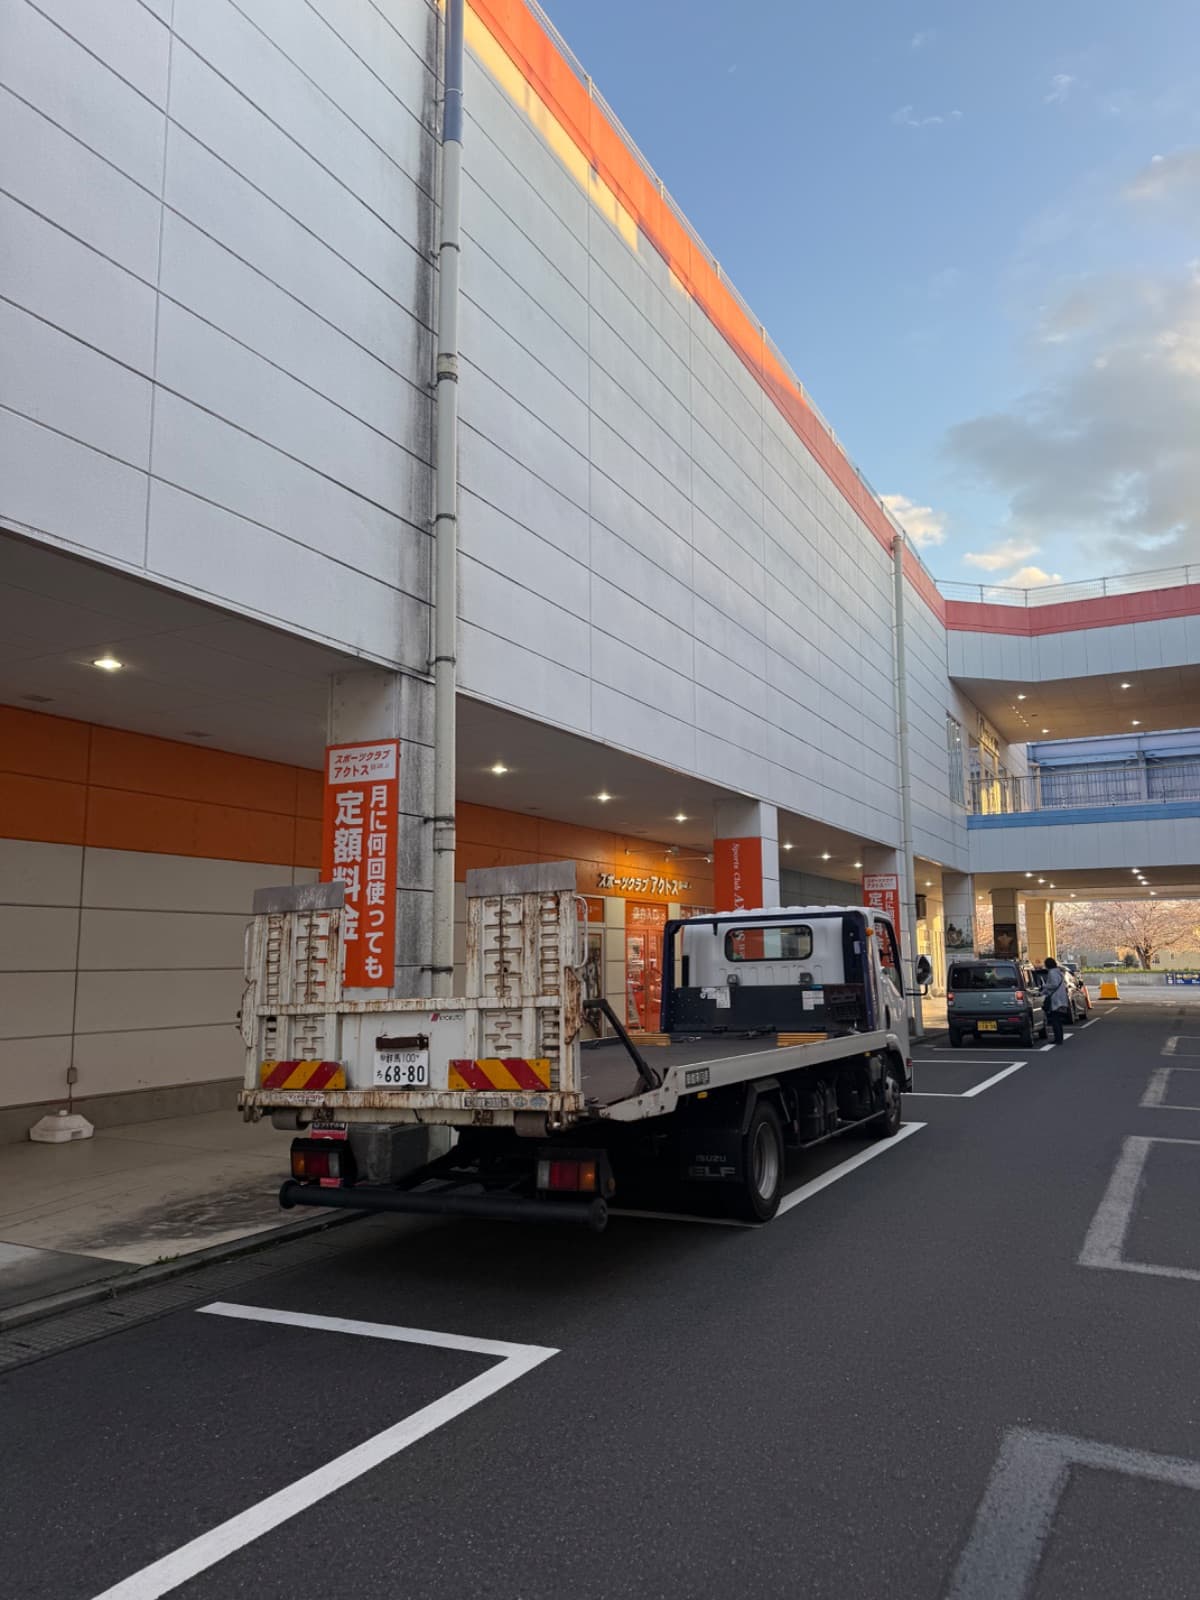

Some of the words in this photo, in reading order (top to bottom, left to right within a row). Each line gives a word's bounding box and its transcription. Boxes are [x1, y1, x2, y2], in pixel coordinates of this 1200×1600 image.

[334, 749, 392, 764] スポーツクラブ
[334, 764, 369, 779] アクトス
[365, 785, 388, 980] 月に何回使っても
[598, 873, 650, 893] スポーツクラブ
[650, 876, 680, 896] アクトス
[384, 1065, 425, 1083] 68-80
[689, 1166, 736, 1177] ELF
